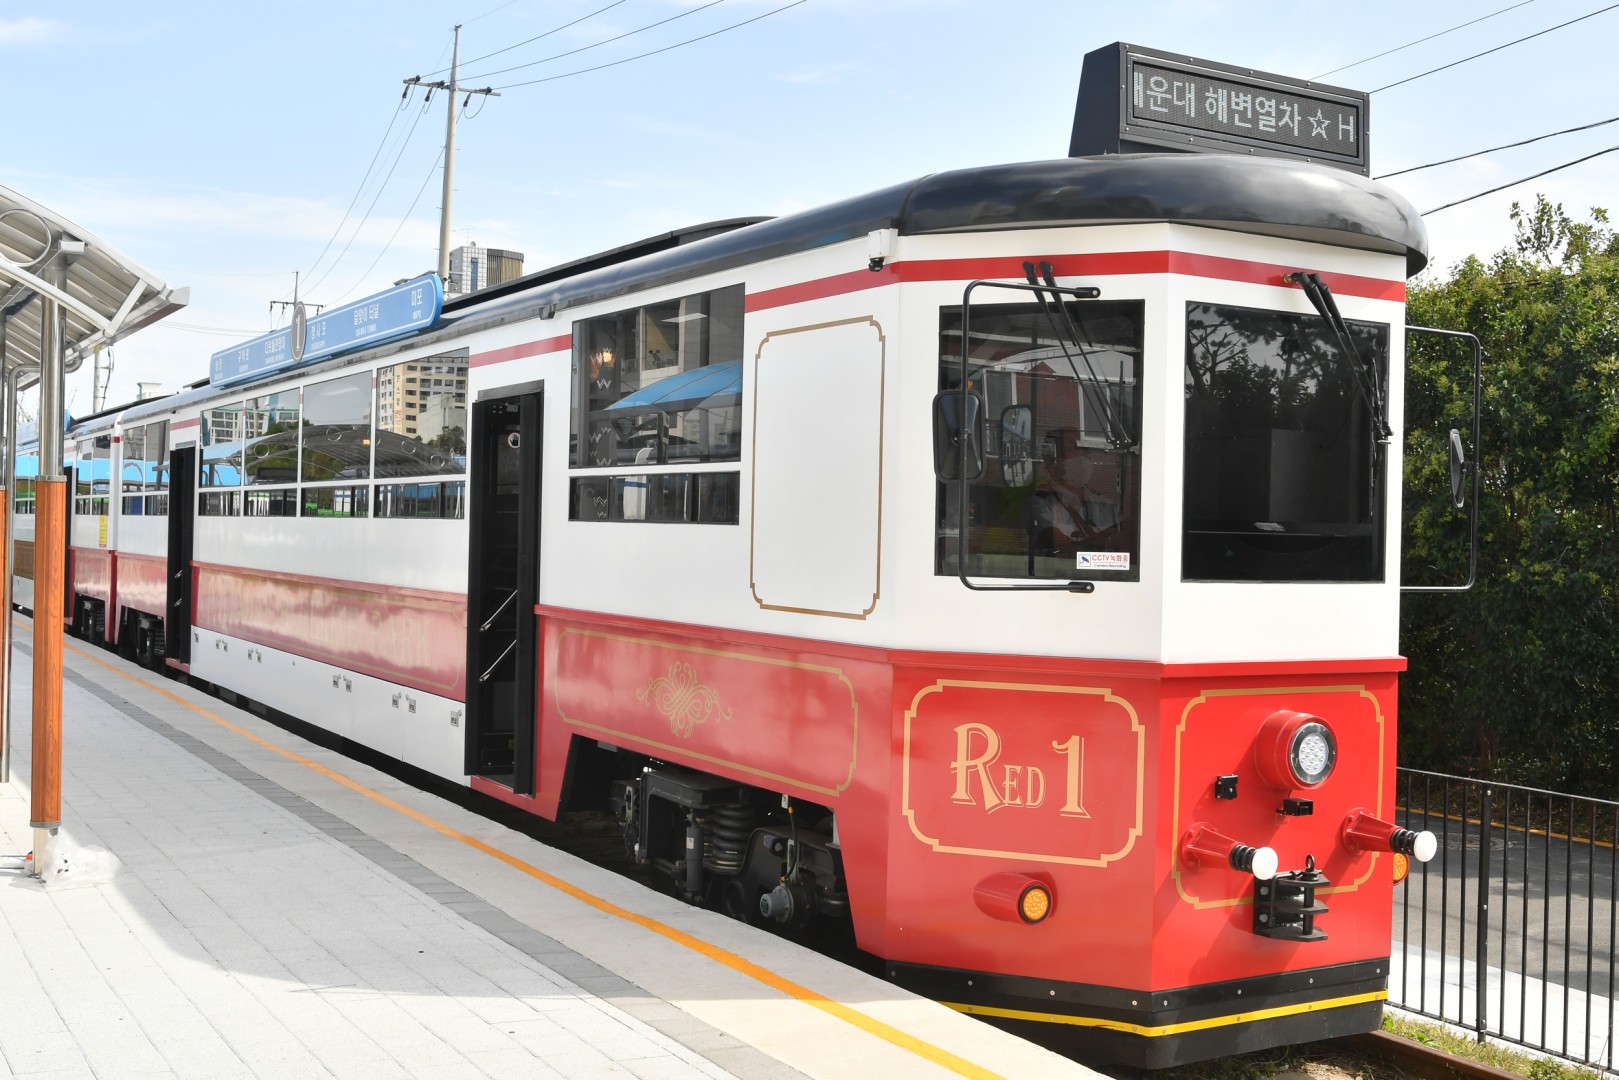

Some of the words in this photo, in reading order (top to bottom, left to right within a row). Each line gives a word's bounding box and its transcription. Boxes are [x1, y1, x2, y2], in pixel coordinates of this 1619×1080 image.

[1204, 87, 1302, 137] 해변열차
[411, 288, 423, 307] 미포
[353, 306, 368, 326] 달맞이
[369, 303, 379, 320] 터널
[295, 314, 301, 352] 1
[311, 321, 326, 340] 청사포
[1051, 735, 1092, 819] 1
